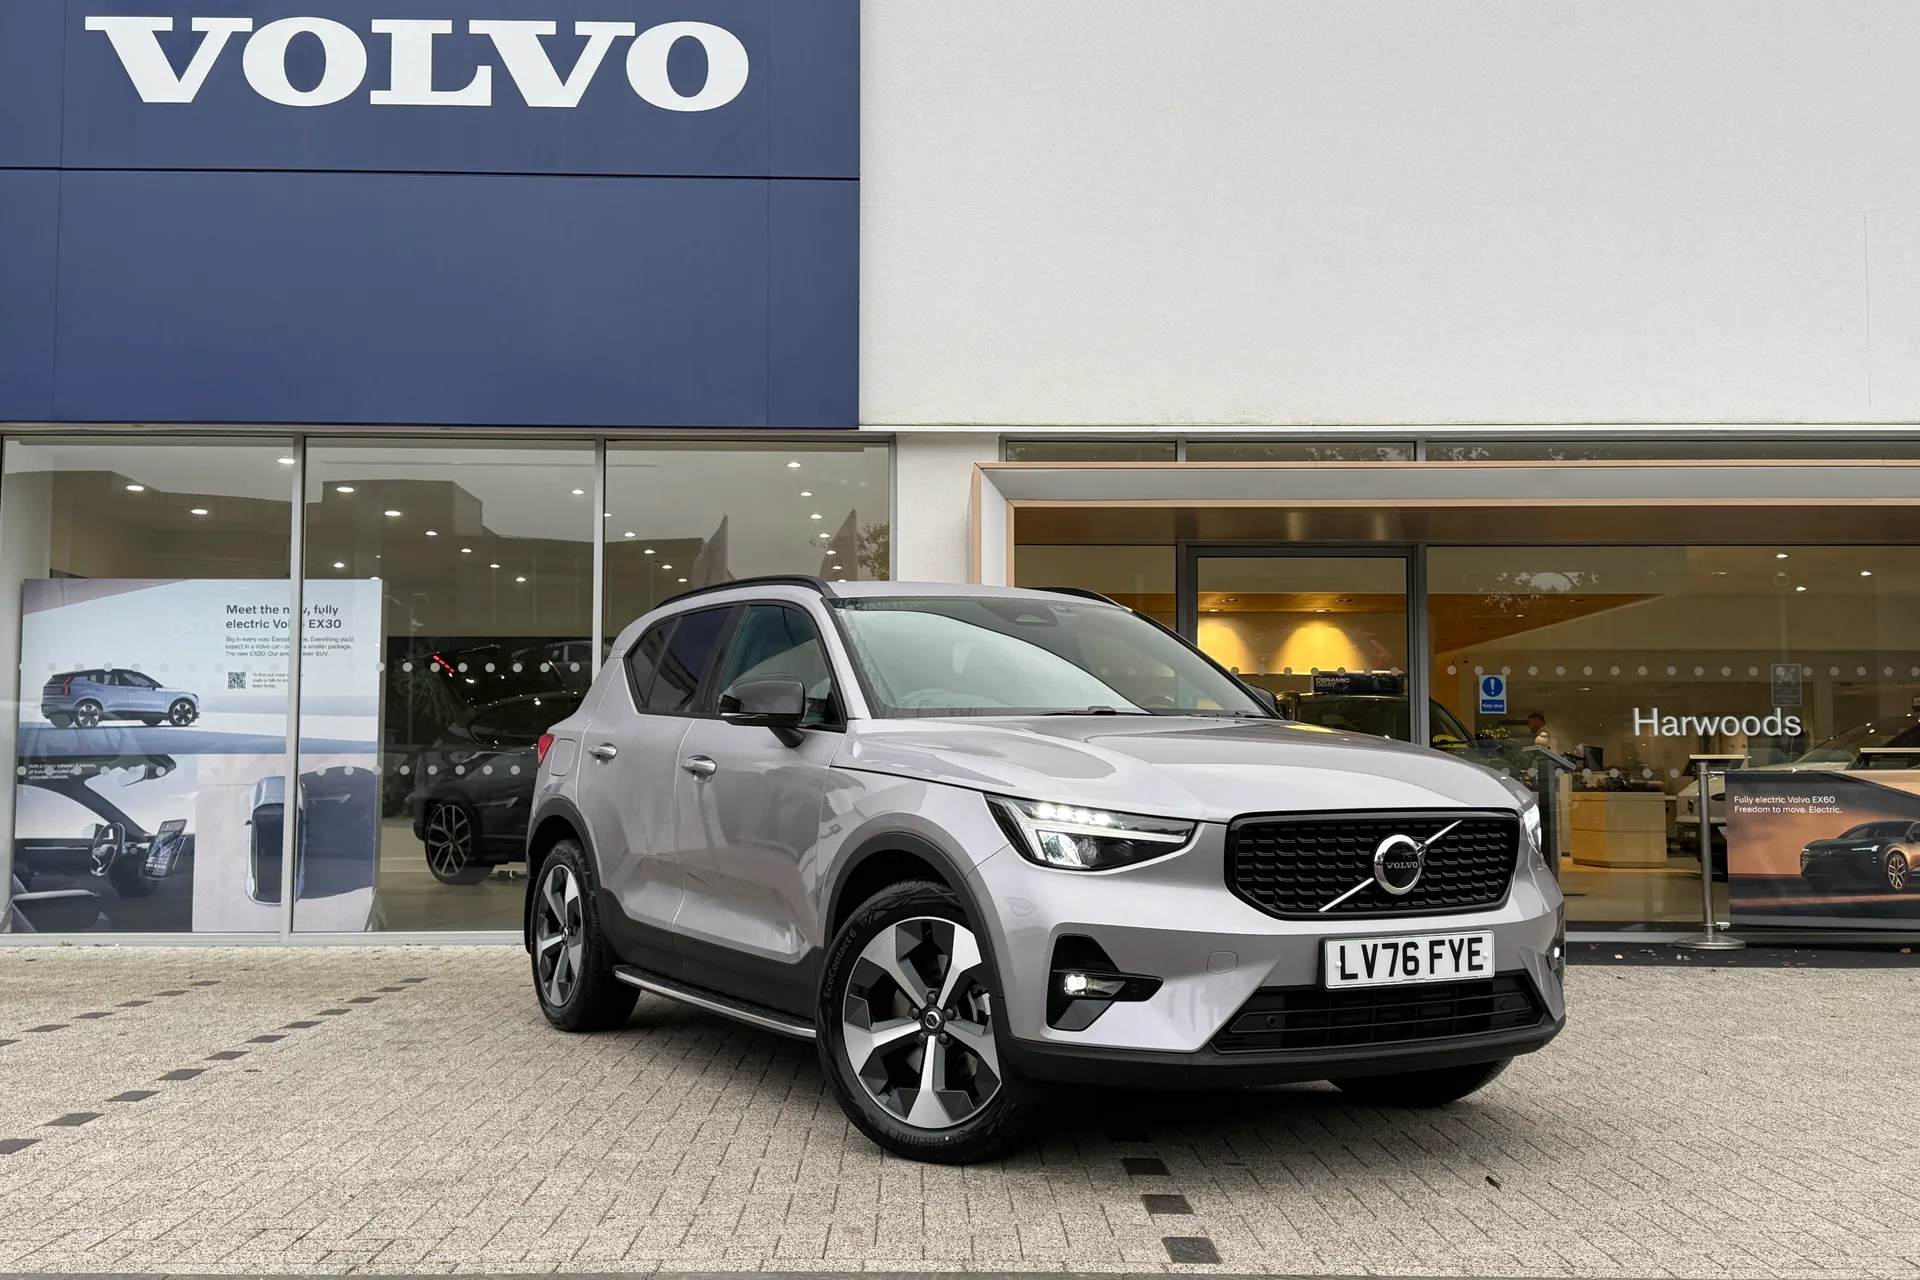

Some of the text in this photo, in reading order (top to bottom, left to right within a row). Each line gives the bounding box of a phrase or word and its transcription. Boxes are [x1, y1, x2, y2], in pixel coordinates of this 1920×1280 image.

[85, 15, 750, 112] VOLVO
[226, 604, 257, 614] Meet
[260, 604, 279, 614] the
[314, 604, 339, 616] fully
[226, 618, 342, 629] electric Vol EX30
[1632, 707, 1802, 736] Harwoods
[1734, 796, 1836, 805] Fully electric Volvo EX60
[1734, 805, 1770, 813] Freedom
[1808, 805, 1843, 813] Electric.
[1385, 861, 1418, 869] VOLVO
[1339, 937, 1484, 980] LV76 FYE
[823, 936, 852, 998] EcoContact
